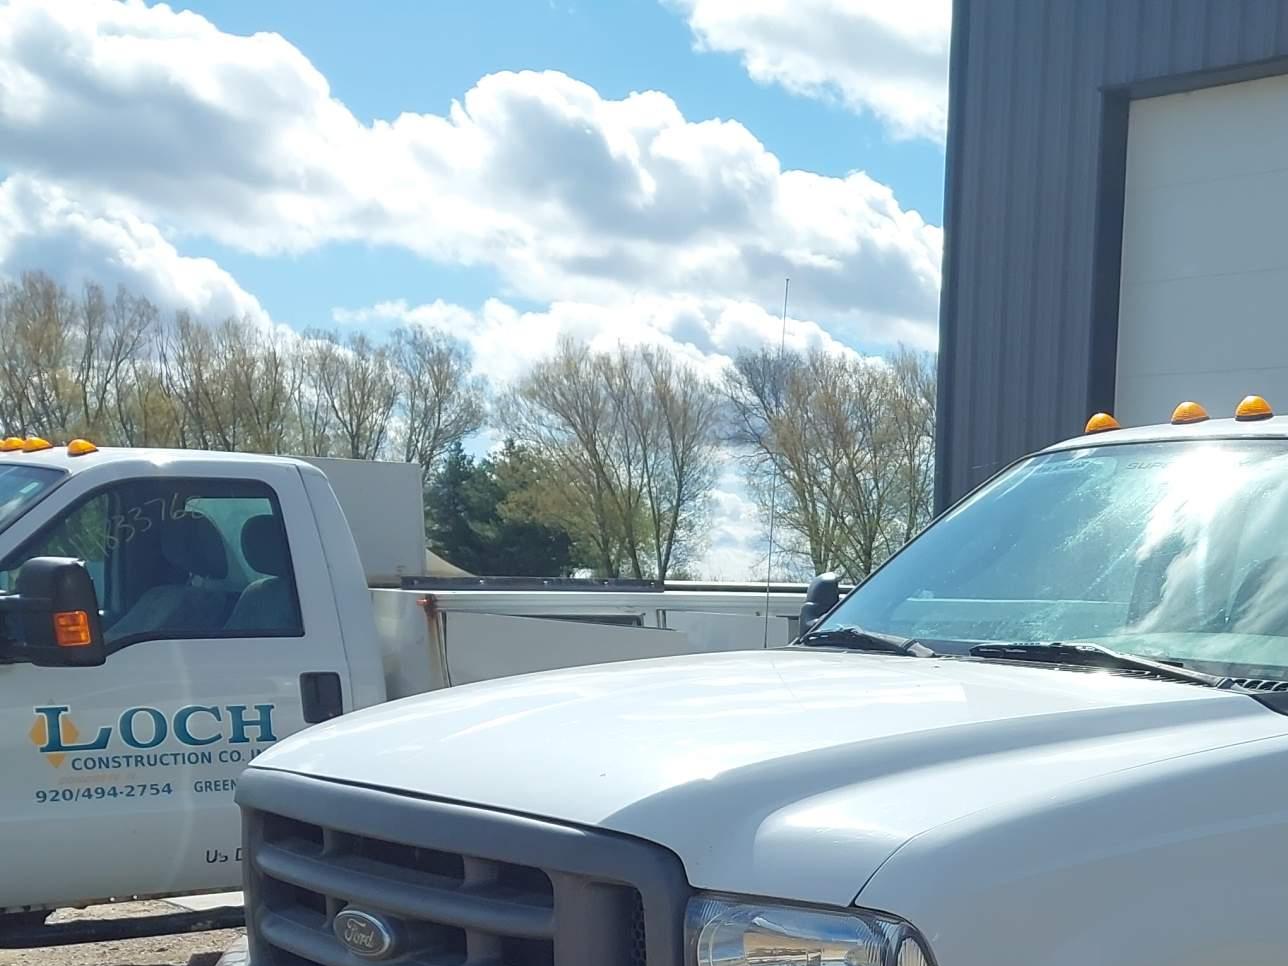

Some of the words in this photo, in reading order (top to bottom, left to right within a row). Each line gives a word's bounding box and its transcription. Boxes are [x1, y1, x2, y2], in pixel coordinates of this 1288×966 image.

[33, 703, 278, 753] LOCH
[71, 752, 212, 771] CONSTRUCTION
[218, 750, 245, 763] CO.
[35, 782, 173, 803] 920/494-2754
[344, 918, 376, 948] Ford
